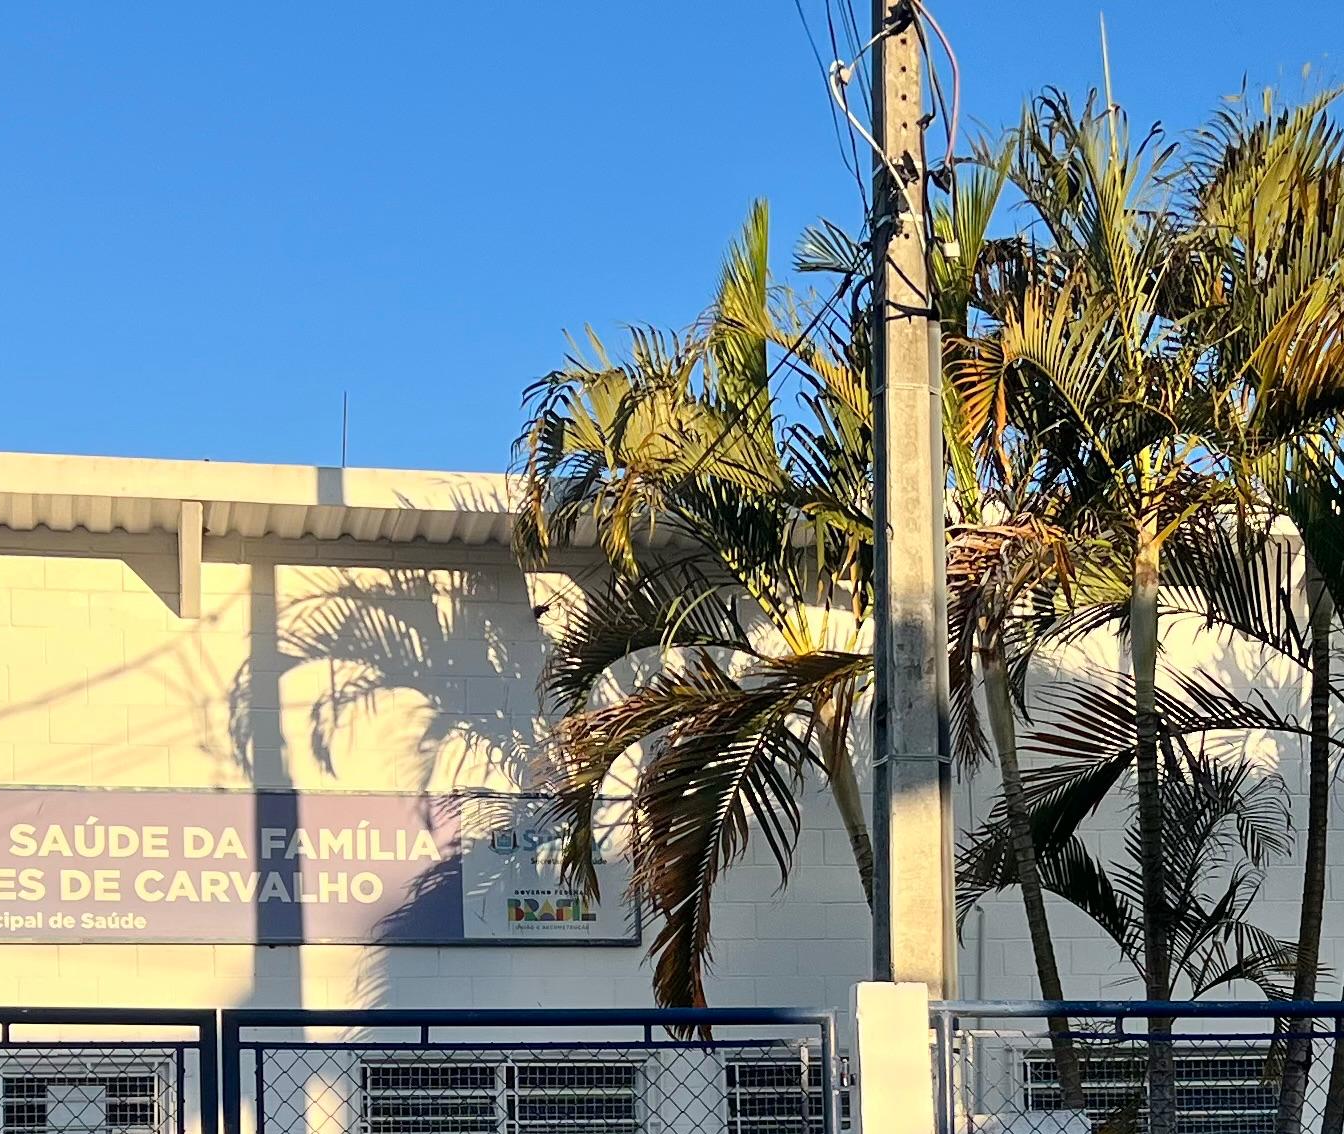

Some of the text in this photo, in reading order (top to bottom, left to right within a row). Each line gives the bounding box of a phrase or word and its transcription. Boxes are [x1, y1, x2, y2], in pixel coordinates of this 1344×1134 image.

[8, 815, 170, 858] SAÚDE
[182, 825, 248, 860] DA
[260, 819, 442, 861] FAMÍLIA
[59, 869, 121, 902] DE
[133, 869, 384, 904] CARVALHO
[48, 912, 76, 930] de
[80, 911, 148, 930] Saúde
[507, 898, 597, 922] BRASIL
